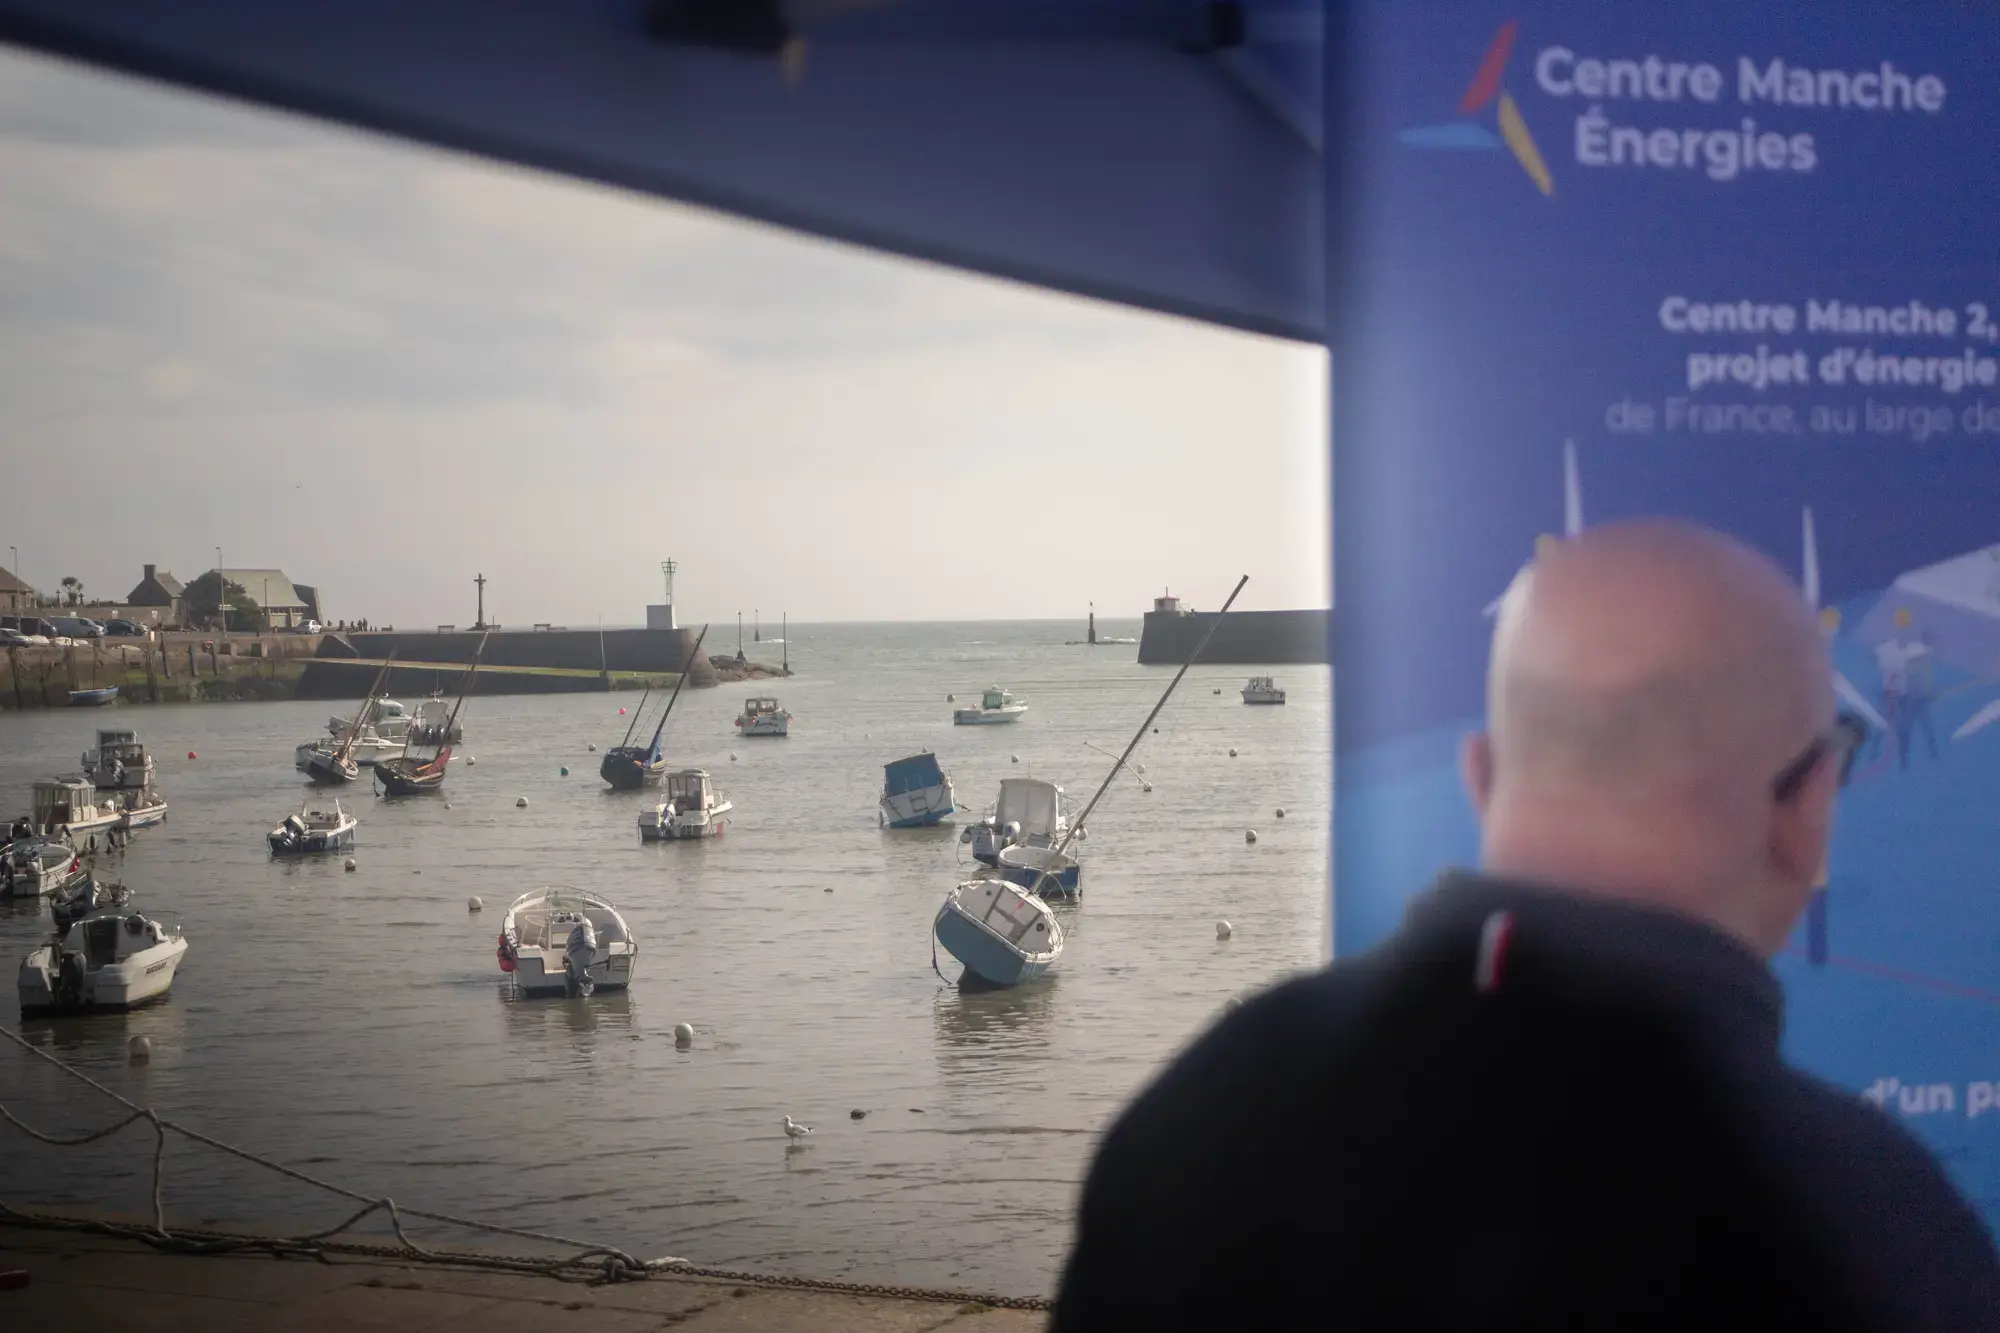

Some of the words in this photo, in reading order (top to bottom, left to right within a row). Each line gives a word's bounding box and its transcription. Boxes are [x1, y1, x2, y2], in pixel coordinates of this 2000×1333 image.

[1535, 45, 1722, 100] Centre
[1737, 56, 1947, 112] Manche
[1575, 102, 1818, 180] Énergies
[1659, 297, 1796, 334] Centre
[1806, 300, 1957, 336] Manche
[1965, 302, 1998, 342] 2,
[1687, 344, 1809, 391] projet
[1819, 346, 1999, 393] d'énergie
[1605, 397, 1656, 433] de
[1664, 397, 1798, 437] France,
[1809, 404, 1857, 434] au
[1866, 398, 1955, 442] large
